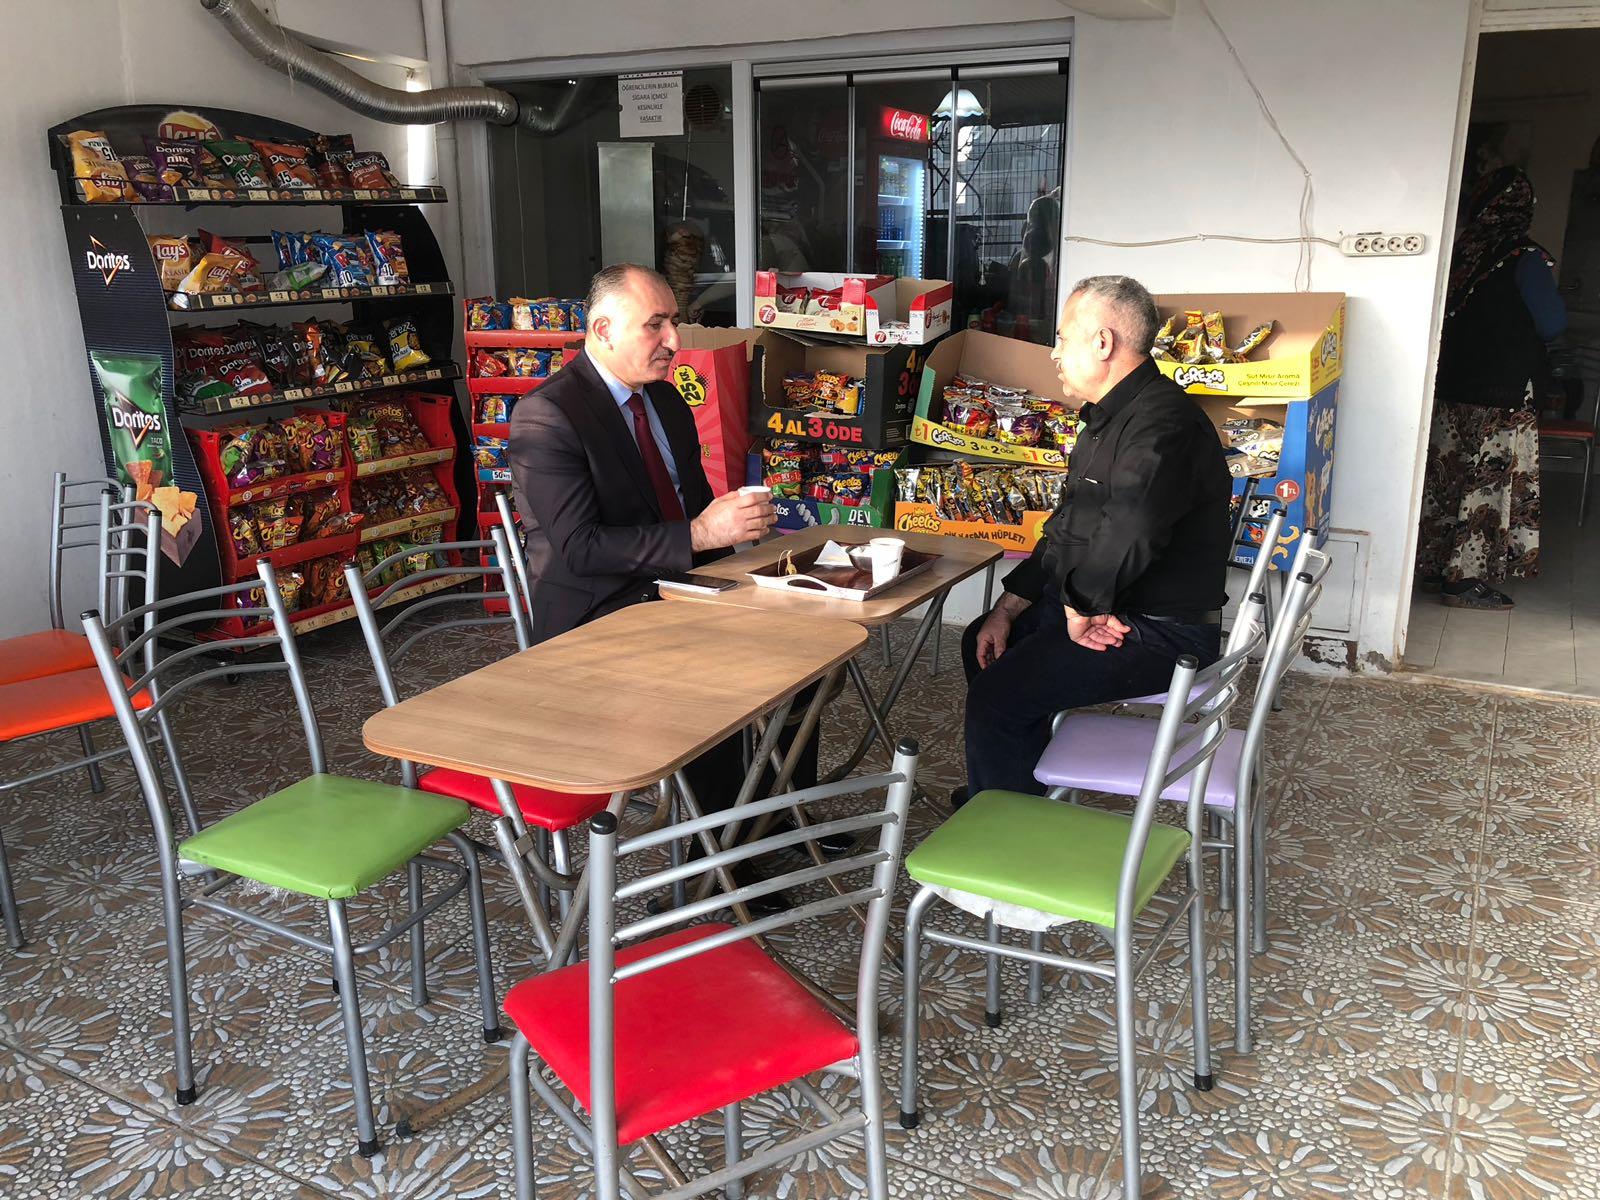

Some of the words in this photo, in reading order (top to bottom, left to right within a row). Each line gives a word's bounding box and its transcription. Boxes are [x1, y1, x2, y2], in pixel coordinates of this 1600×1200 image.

[87, 251, 131, 270] Doritos
[156, 242, 186, 262] Lay's
[680, 383, 701, 402] 25
[112, 407, 161, 430] Doritos
[767, 412, 783, 433] 4
[785, 420, 806, 436] AL
[808, 417, 823, 438] 3
[826, 422, 862, 442] ÖDE
[833, 477, 862, 494] Cheetos
[848, 509, 871, 524] DEV
[898, 513, 941, 532] Cheetos
